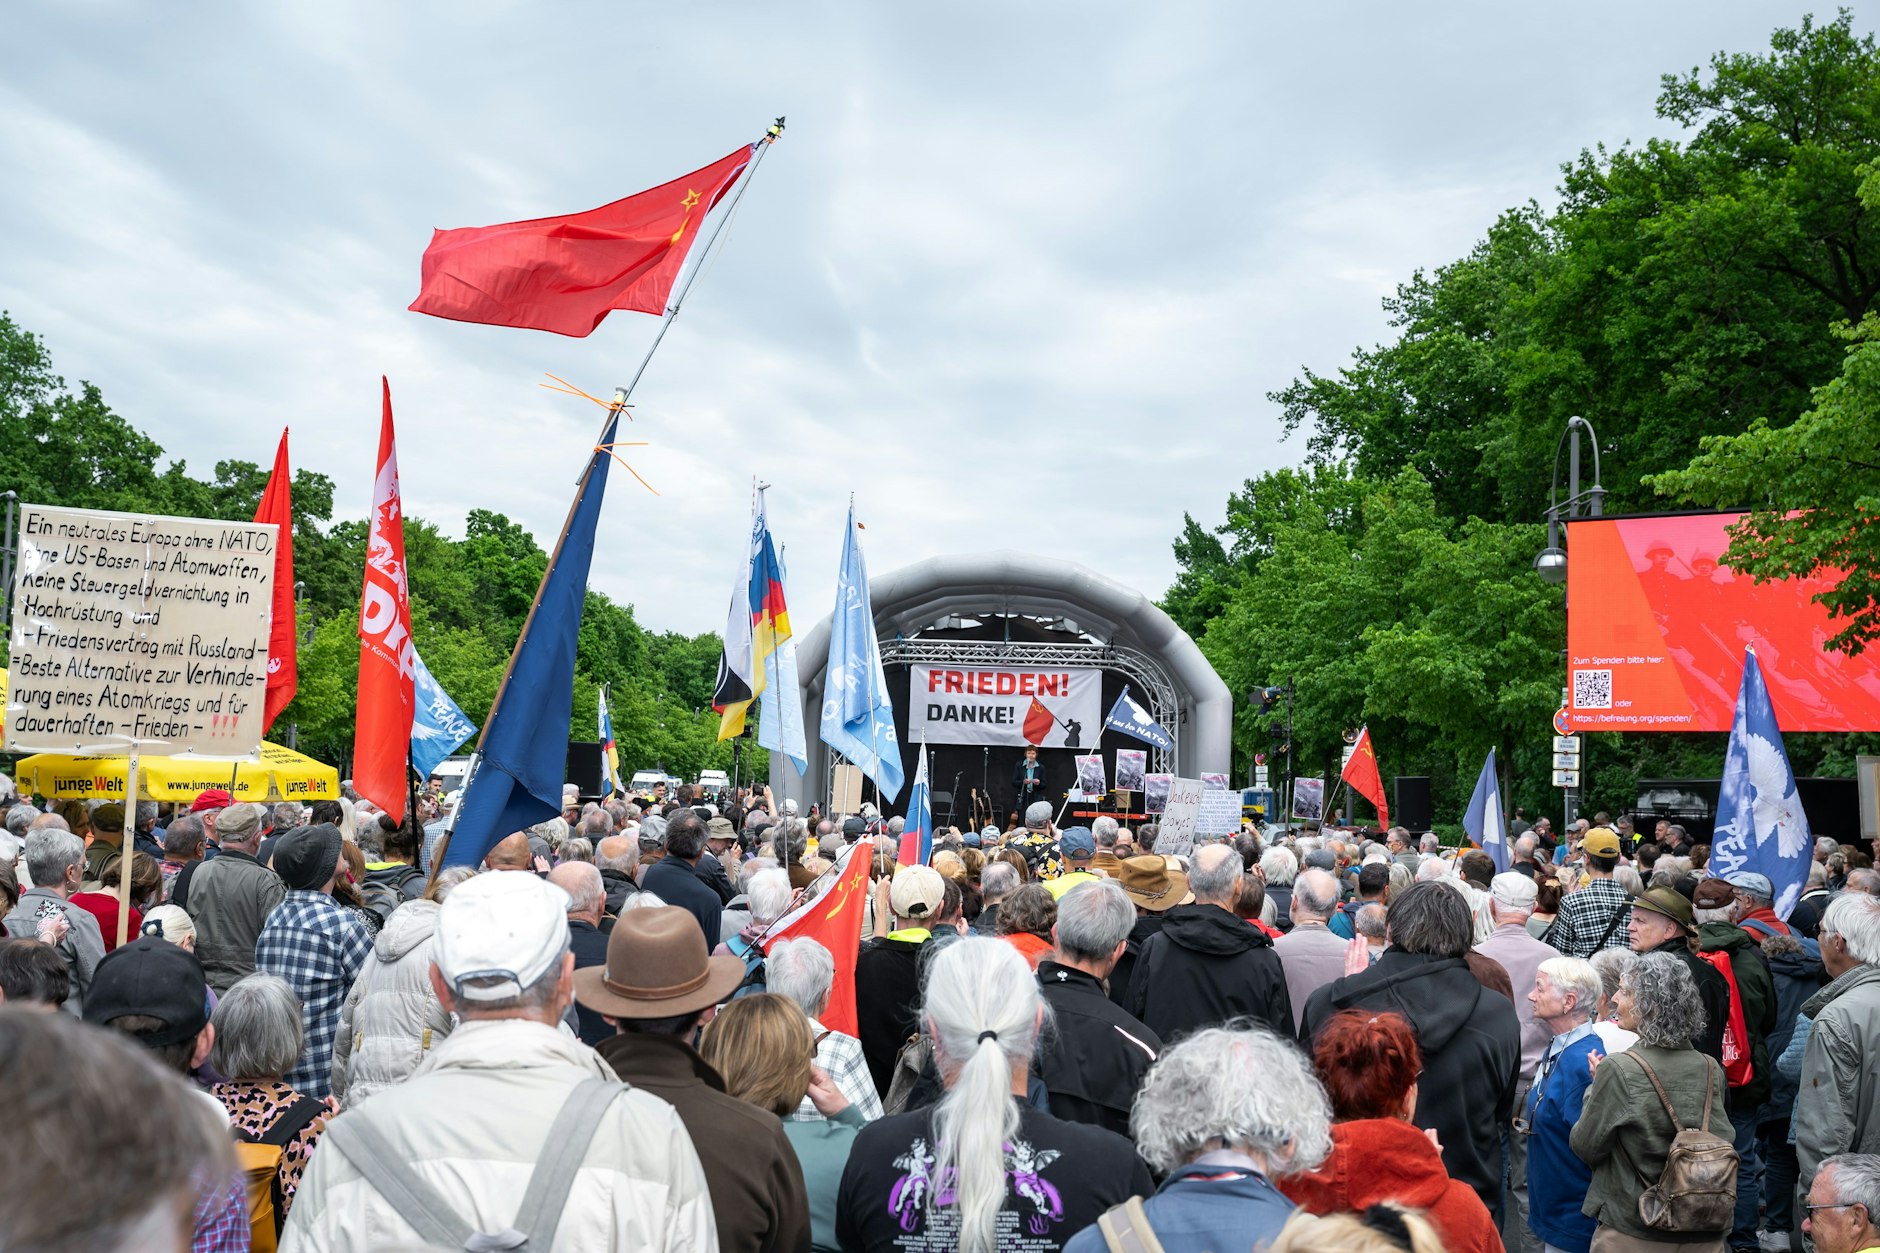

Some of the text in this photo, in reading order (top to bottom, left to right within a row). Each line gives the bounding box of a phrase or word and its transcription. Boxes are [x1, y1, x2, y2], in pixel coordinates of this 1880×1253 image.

[27, 513, 272, 556] Ein neutrales Europa ohne NATO,
[65, 543, 139, 569] US-Basen
[144, 551, 169, 572] und
[170, 551, 266, 583] Atomwaffen,
[70, 572, 229, 608] Steuergeldvernichtung
[236, 585, 249, 604] in
[24, 594, 161, 628] Hochrüstung und
[162, 637, 184, 656] mit
[66, 656, 152, 683] Alternative
[156, 669, 181, 683] zur
[1592, 656, 1625, 665] Spenden
[928, 670, 1069, 697] FRIEDEN!
[14, 688, 51, 709] rung
[56, 685, 93, 706] eines
[197, 692, 223, 713] und
[229, 693, 248, 714] für
[15, 709, 114, 736] dauerhaften
[428, 697, 473, 742] PEACE
[927, 703, 1015, 724] DANKE!
[1573, 714, 1692, 724] https://befreiung.org/spenden/
[1136, 727, 1169, 747] NATO!
[167, 780, 249, 792] www.jungewel.de
[1714, 817, 1748, 880] PEA
